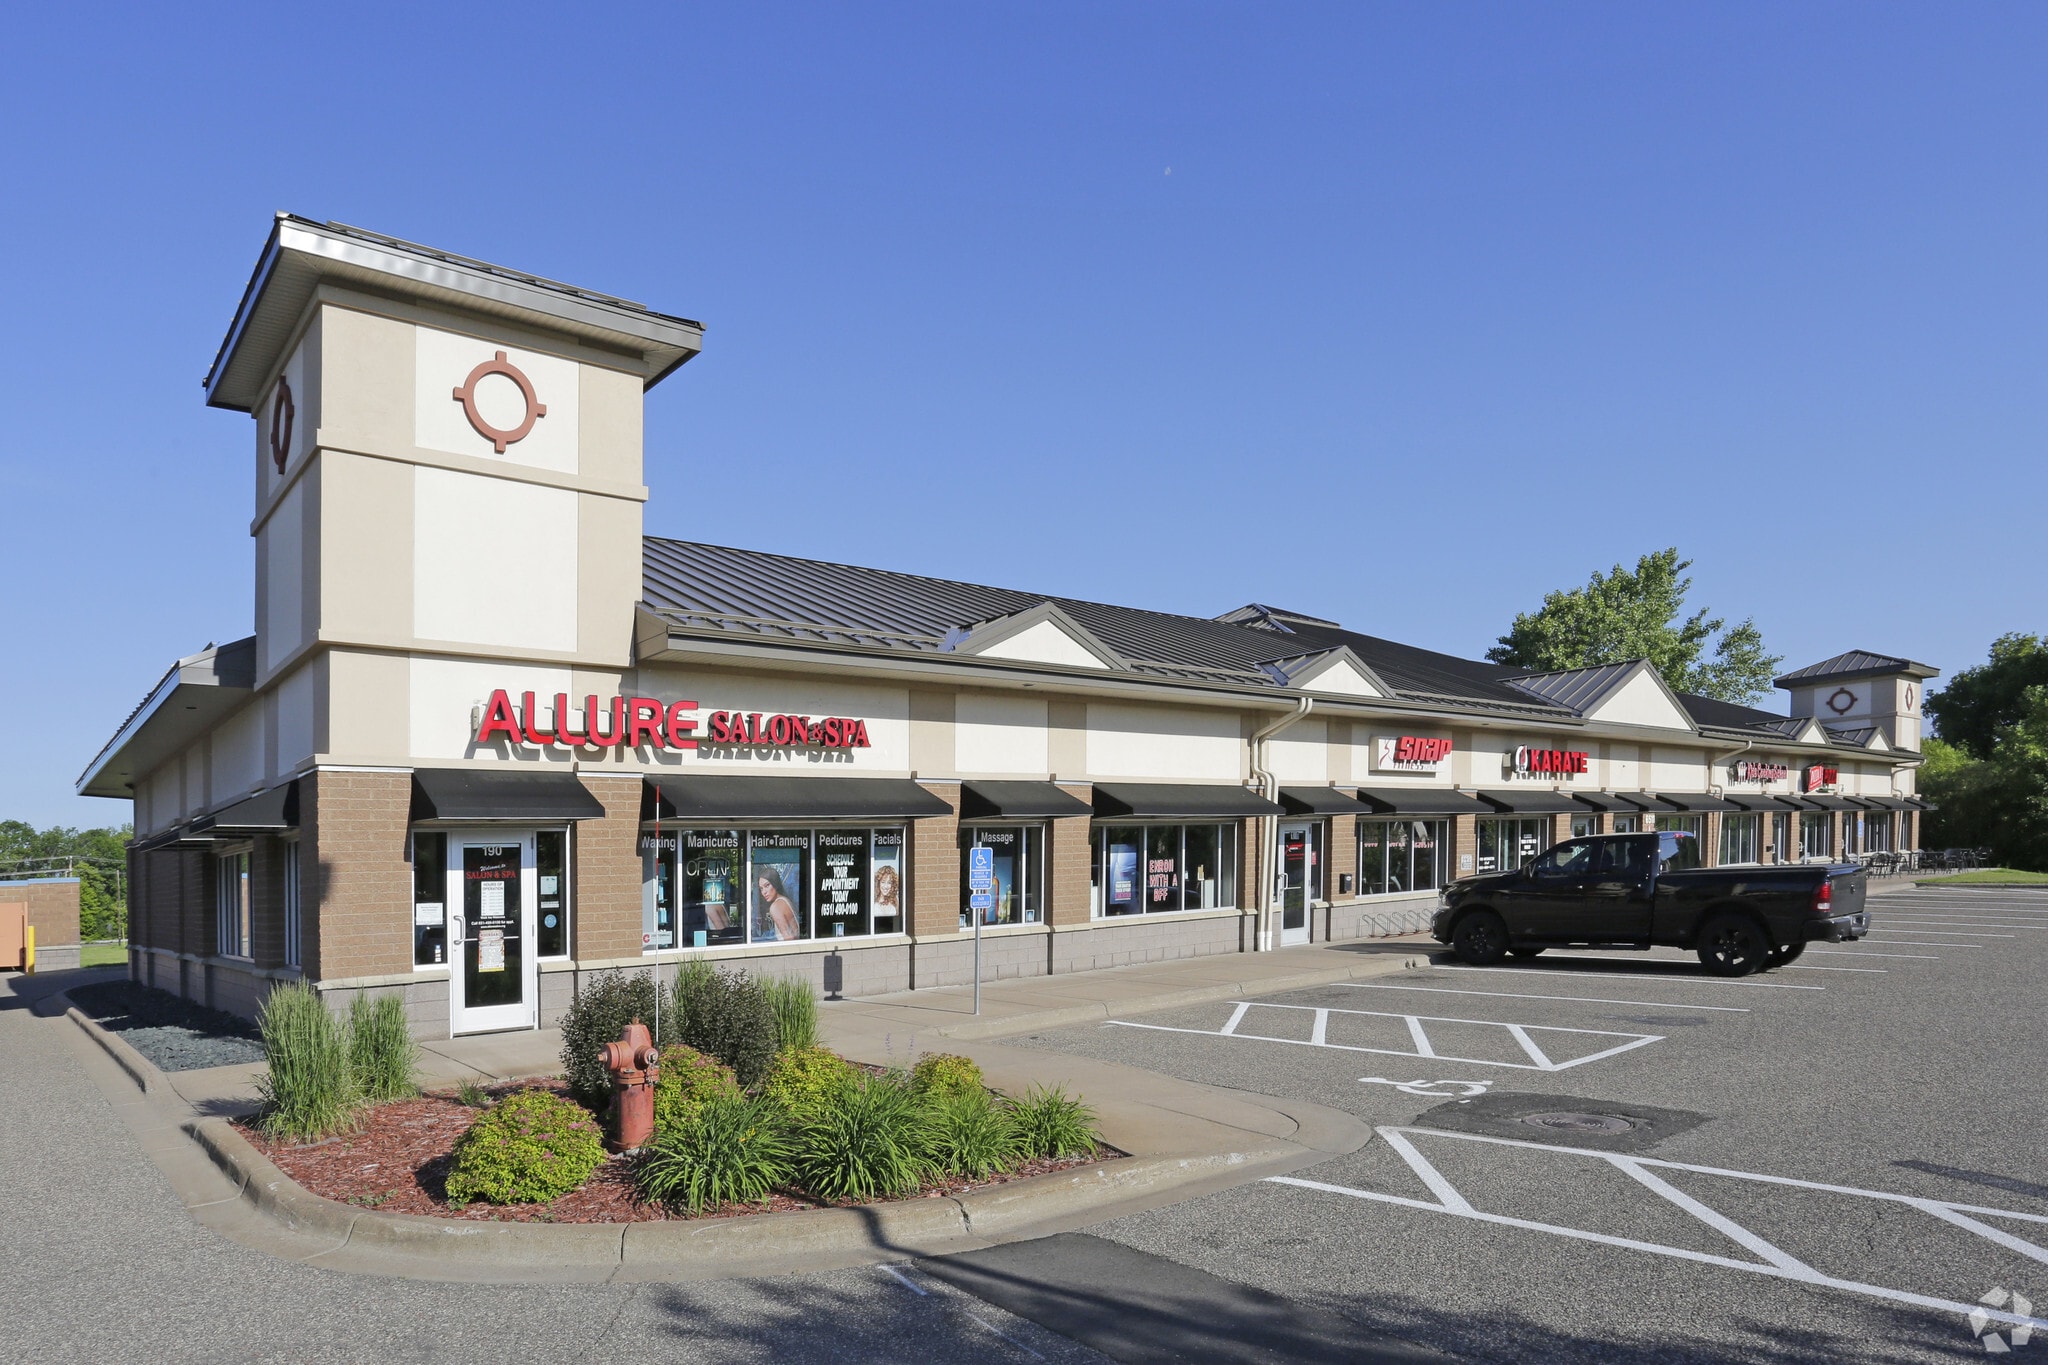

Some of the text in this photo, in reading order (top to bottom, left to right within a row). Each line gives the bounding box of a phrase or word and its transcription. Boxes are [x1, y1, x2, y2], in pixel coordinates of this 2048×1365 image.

[476, 689, 871, 749] ALLURE SALON & SPA
[1531, 749, 1588, 773] KARATE
[642, 836, 676, 851] Waxing
[687, 835, 739, 848] Manicures
[819, 834, 862, 846] Pedicures
[874, 834, 902, 845] Facials
[981, 832, 1014, 844] Massage
[482, 846, 502, 856] 190
[826, 854, 854, 866] SCHEDULE
[466, 870, 516, 879] SALON & SPA
[686, 860, 728, 876] OPEN
[833, 866, 848, 879] YOUR
[821, 878, 859, 891] APPOINTMENT
[1149, 874, 1178, 887] WITH A
[832, 890, 849, 903] TODAY
[1153, 888, 1168, 901] BFF
